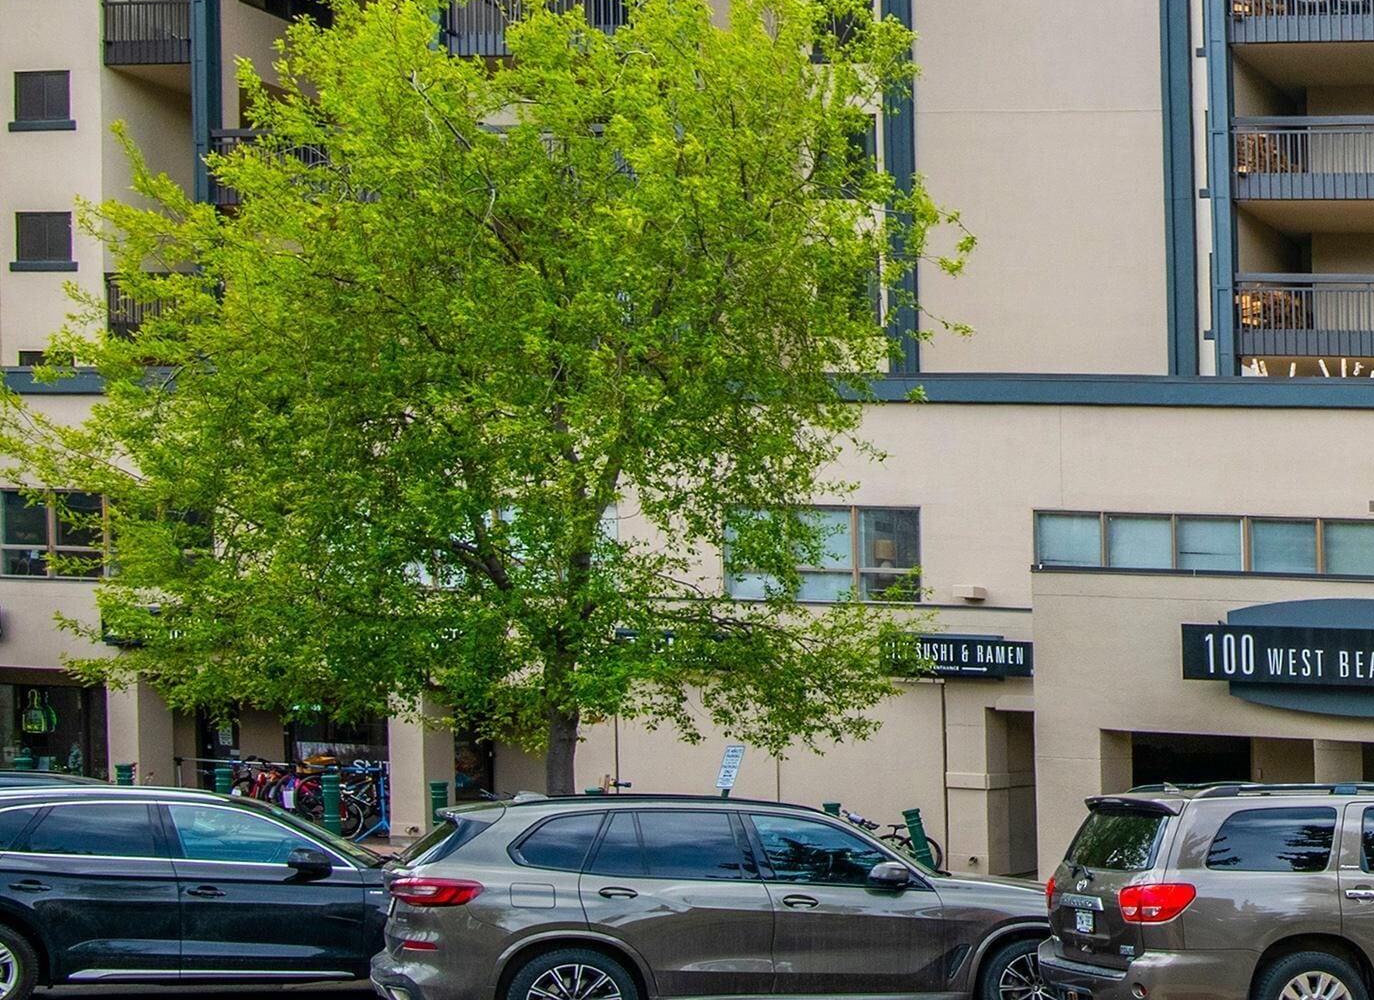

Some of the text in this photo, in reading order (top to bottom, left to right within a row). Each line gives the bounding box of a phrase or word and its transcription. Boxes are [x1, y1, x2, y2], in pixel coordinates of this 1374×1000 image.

[916, 642, 953, 662] SUSHI
[961, 644, 969, 662] &
[976, 645, 1024, 665] RAMEN
[1204, 633, 1255, 675] 100
[1267, 648, 1324, 677] WEST
